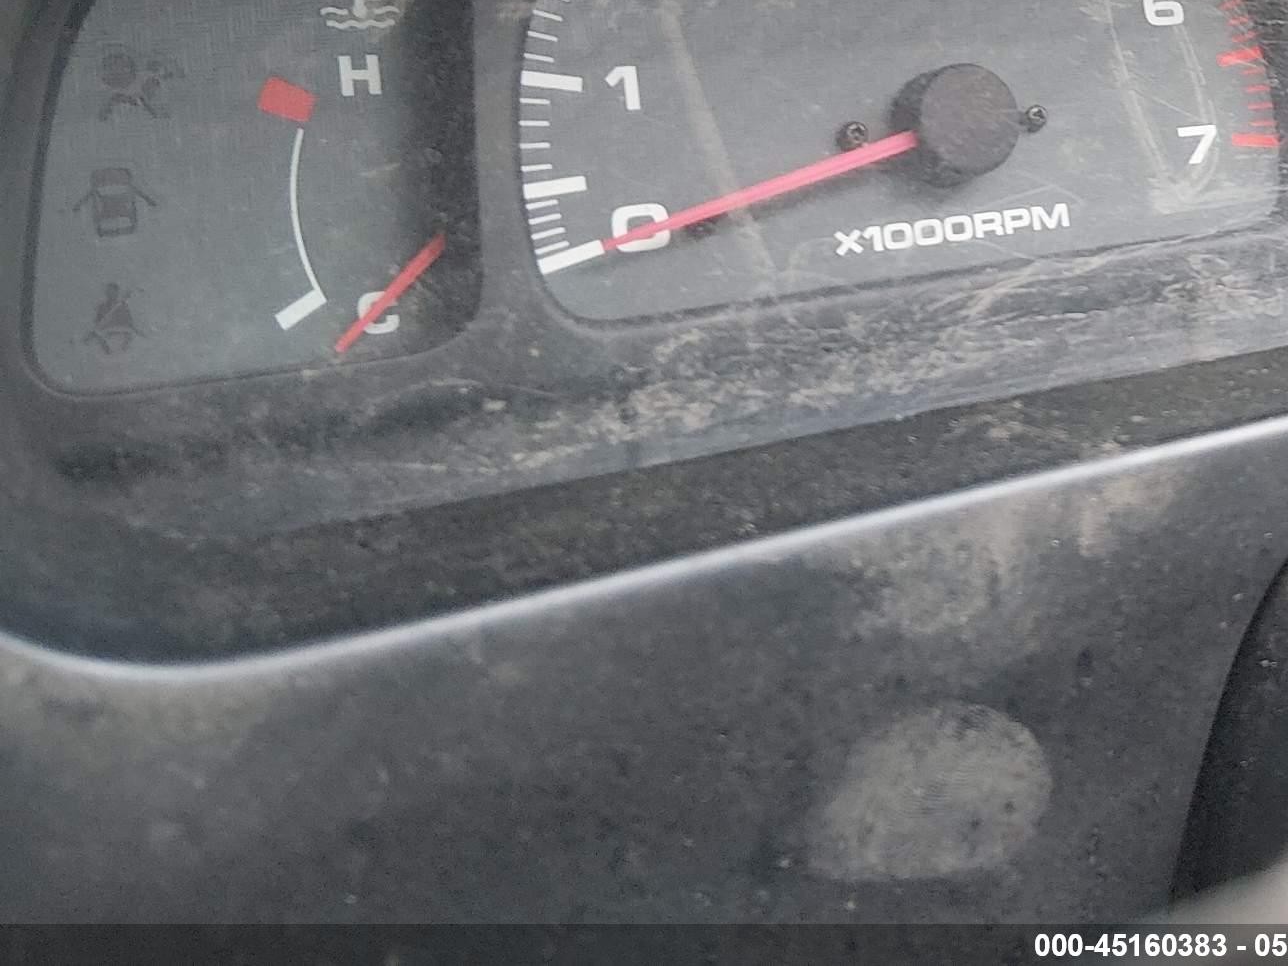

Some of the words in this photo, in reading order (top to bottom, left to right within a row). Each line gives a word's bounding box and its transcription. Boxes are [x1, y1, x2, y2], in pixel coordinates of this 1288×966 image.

[338, 54, 382, 96] H
[604, 66, 642, 111] 1
[1177, 126, 1217, 164] 7
[611, 203, 670, 253] 0
